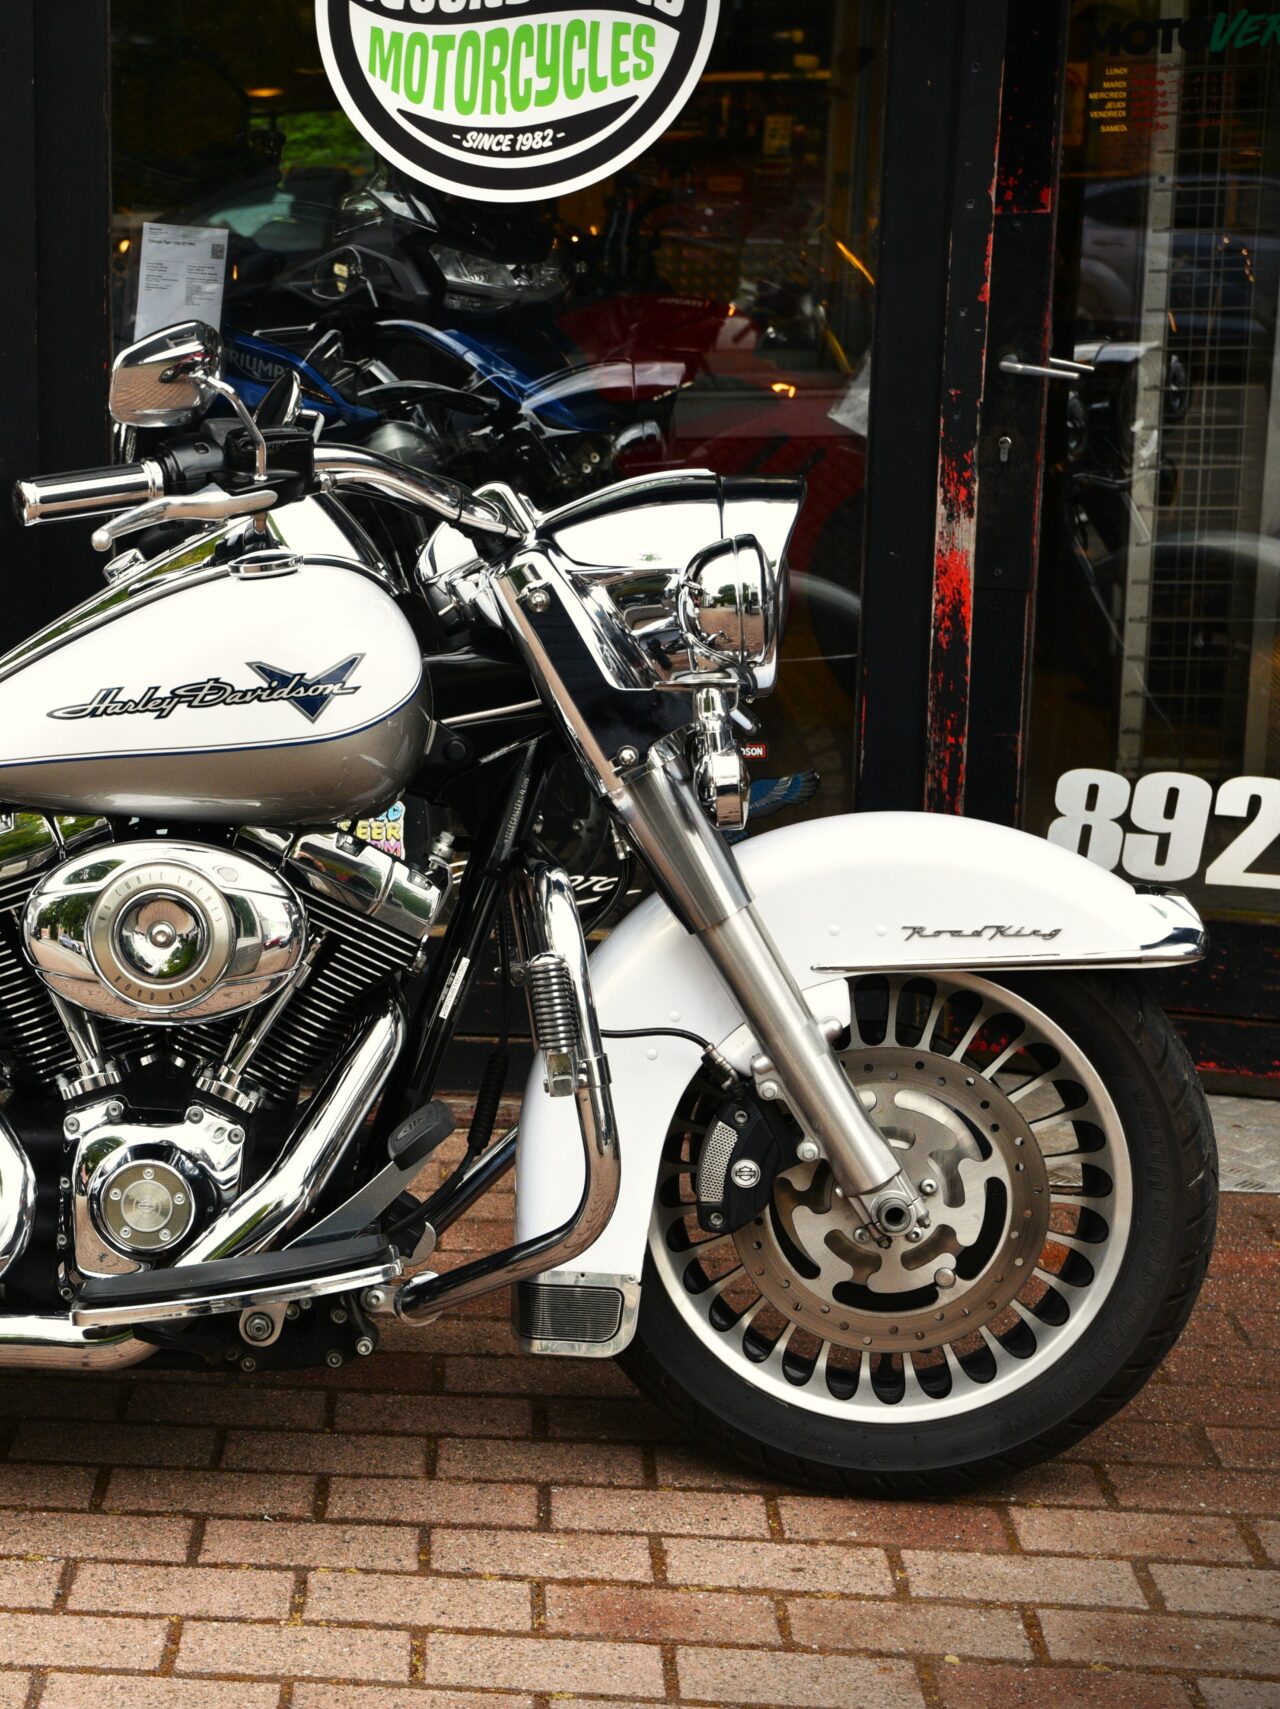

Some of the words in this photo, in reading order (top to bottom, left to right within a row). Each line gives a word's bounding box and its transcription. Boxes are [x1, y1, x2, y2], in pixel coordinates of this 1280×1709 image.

[368, 18, 656, 116] MOTORCYCLES
[1105, 66, 1128, 76] LUNDI
[1103, 81, 1127, 89] MARDI
[1088, 91, 1127, 100] MERCREDI
[1104, 101, 1127, 110] JEUDI
[1089, 110, 1127, 119] VENDREDI
[227, 349, 287, 379] RIUMP
[45, 672, 362, 720] Harley-Davidson
[1047, 768, 1280, 889] 892
